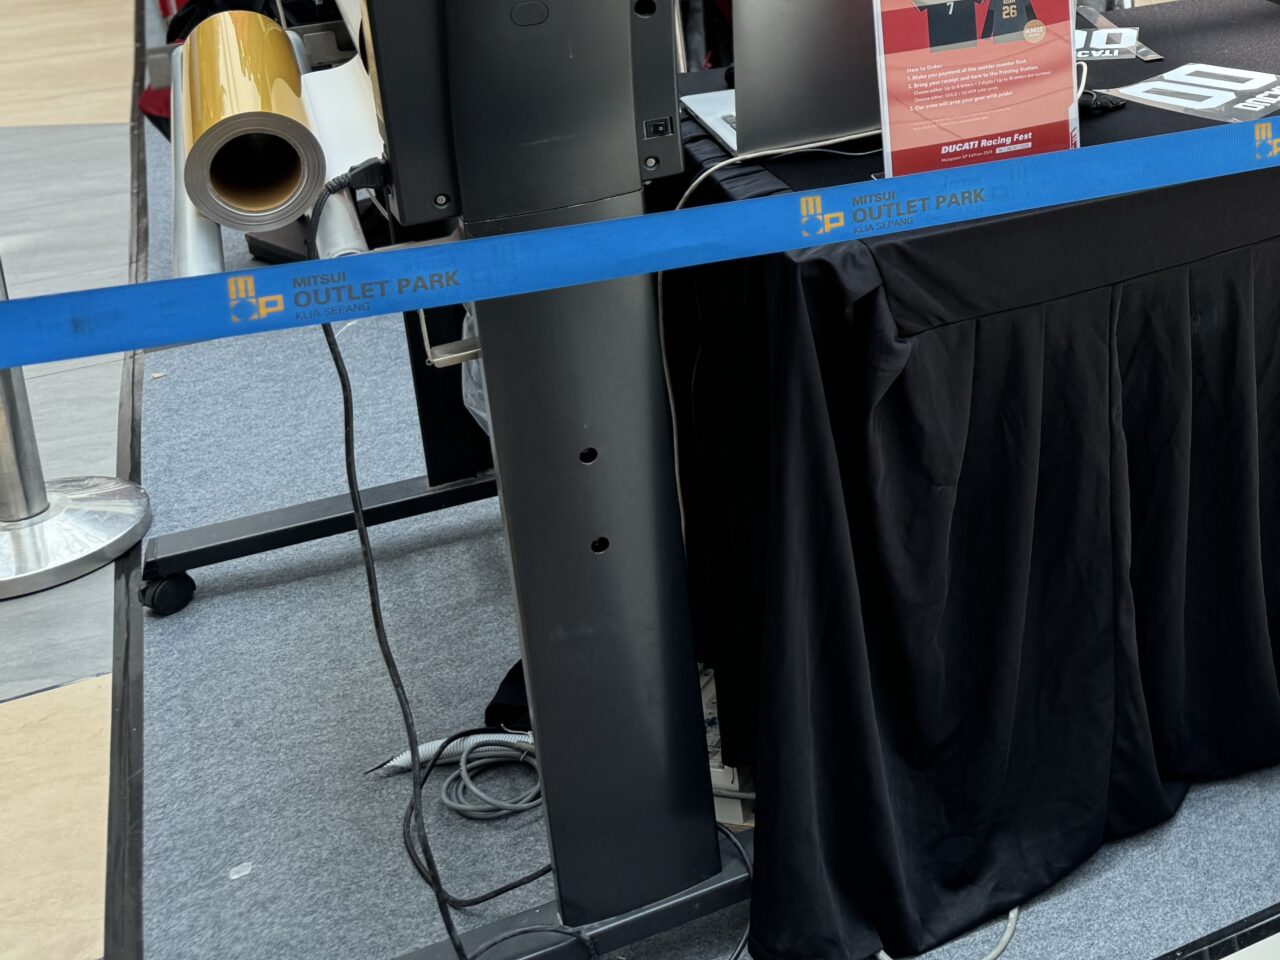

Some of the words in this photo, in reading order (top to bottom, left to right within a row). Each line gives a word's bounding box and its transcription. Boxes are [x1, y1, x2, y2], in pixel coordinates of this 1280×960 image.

[946, 2, 954, 15] 7
[1002, 5, 1018, 19] 26
[926, 62, 943, 70] Order:
[938, 68, 960, 77] payment
[977, 62, 994, 70] cashier
[996, 59, 1014, 67] counter
[913, 81, 928, 89] Bring
[941, 76, 959, 85] receipt
[999, 67, 1018, 76] Printing
[1020, 64, 1039, 72] Station.
[997, 90, 1012, 98] pride!
[941, 141, 978, 154] DUCATI
[980, 135, 1012, 148] Racing
[1014, 132, 1032, 142] Fest
[852, 191, 896, 206] MITSUI
[852, 198, 929, 223] OUTLET
[935, 188, 985, 209] PARK
[854, 224, 874, 234] KLIA
[876, 217, 913, 230] SEPANG
[292, 271, 346, 289] MITSUI
[294, 280, 389, 308] OUTLET
[397, 270, 460, 294] PARK
[295, 308, 321, 321] KLIA
[324, 302, 370, 316] SEPANG
